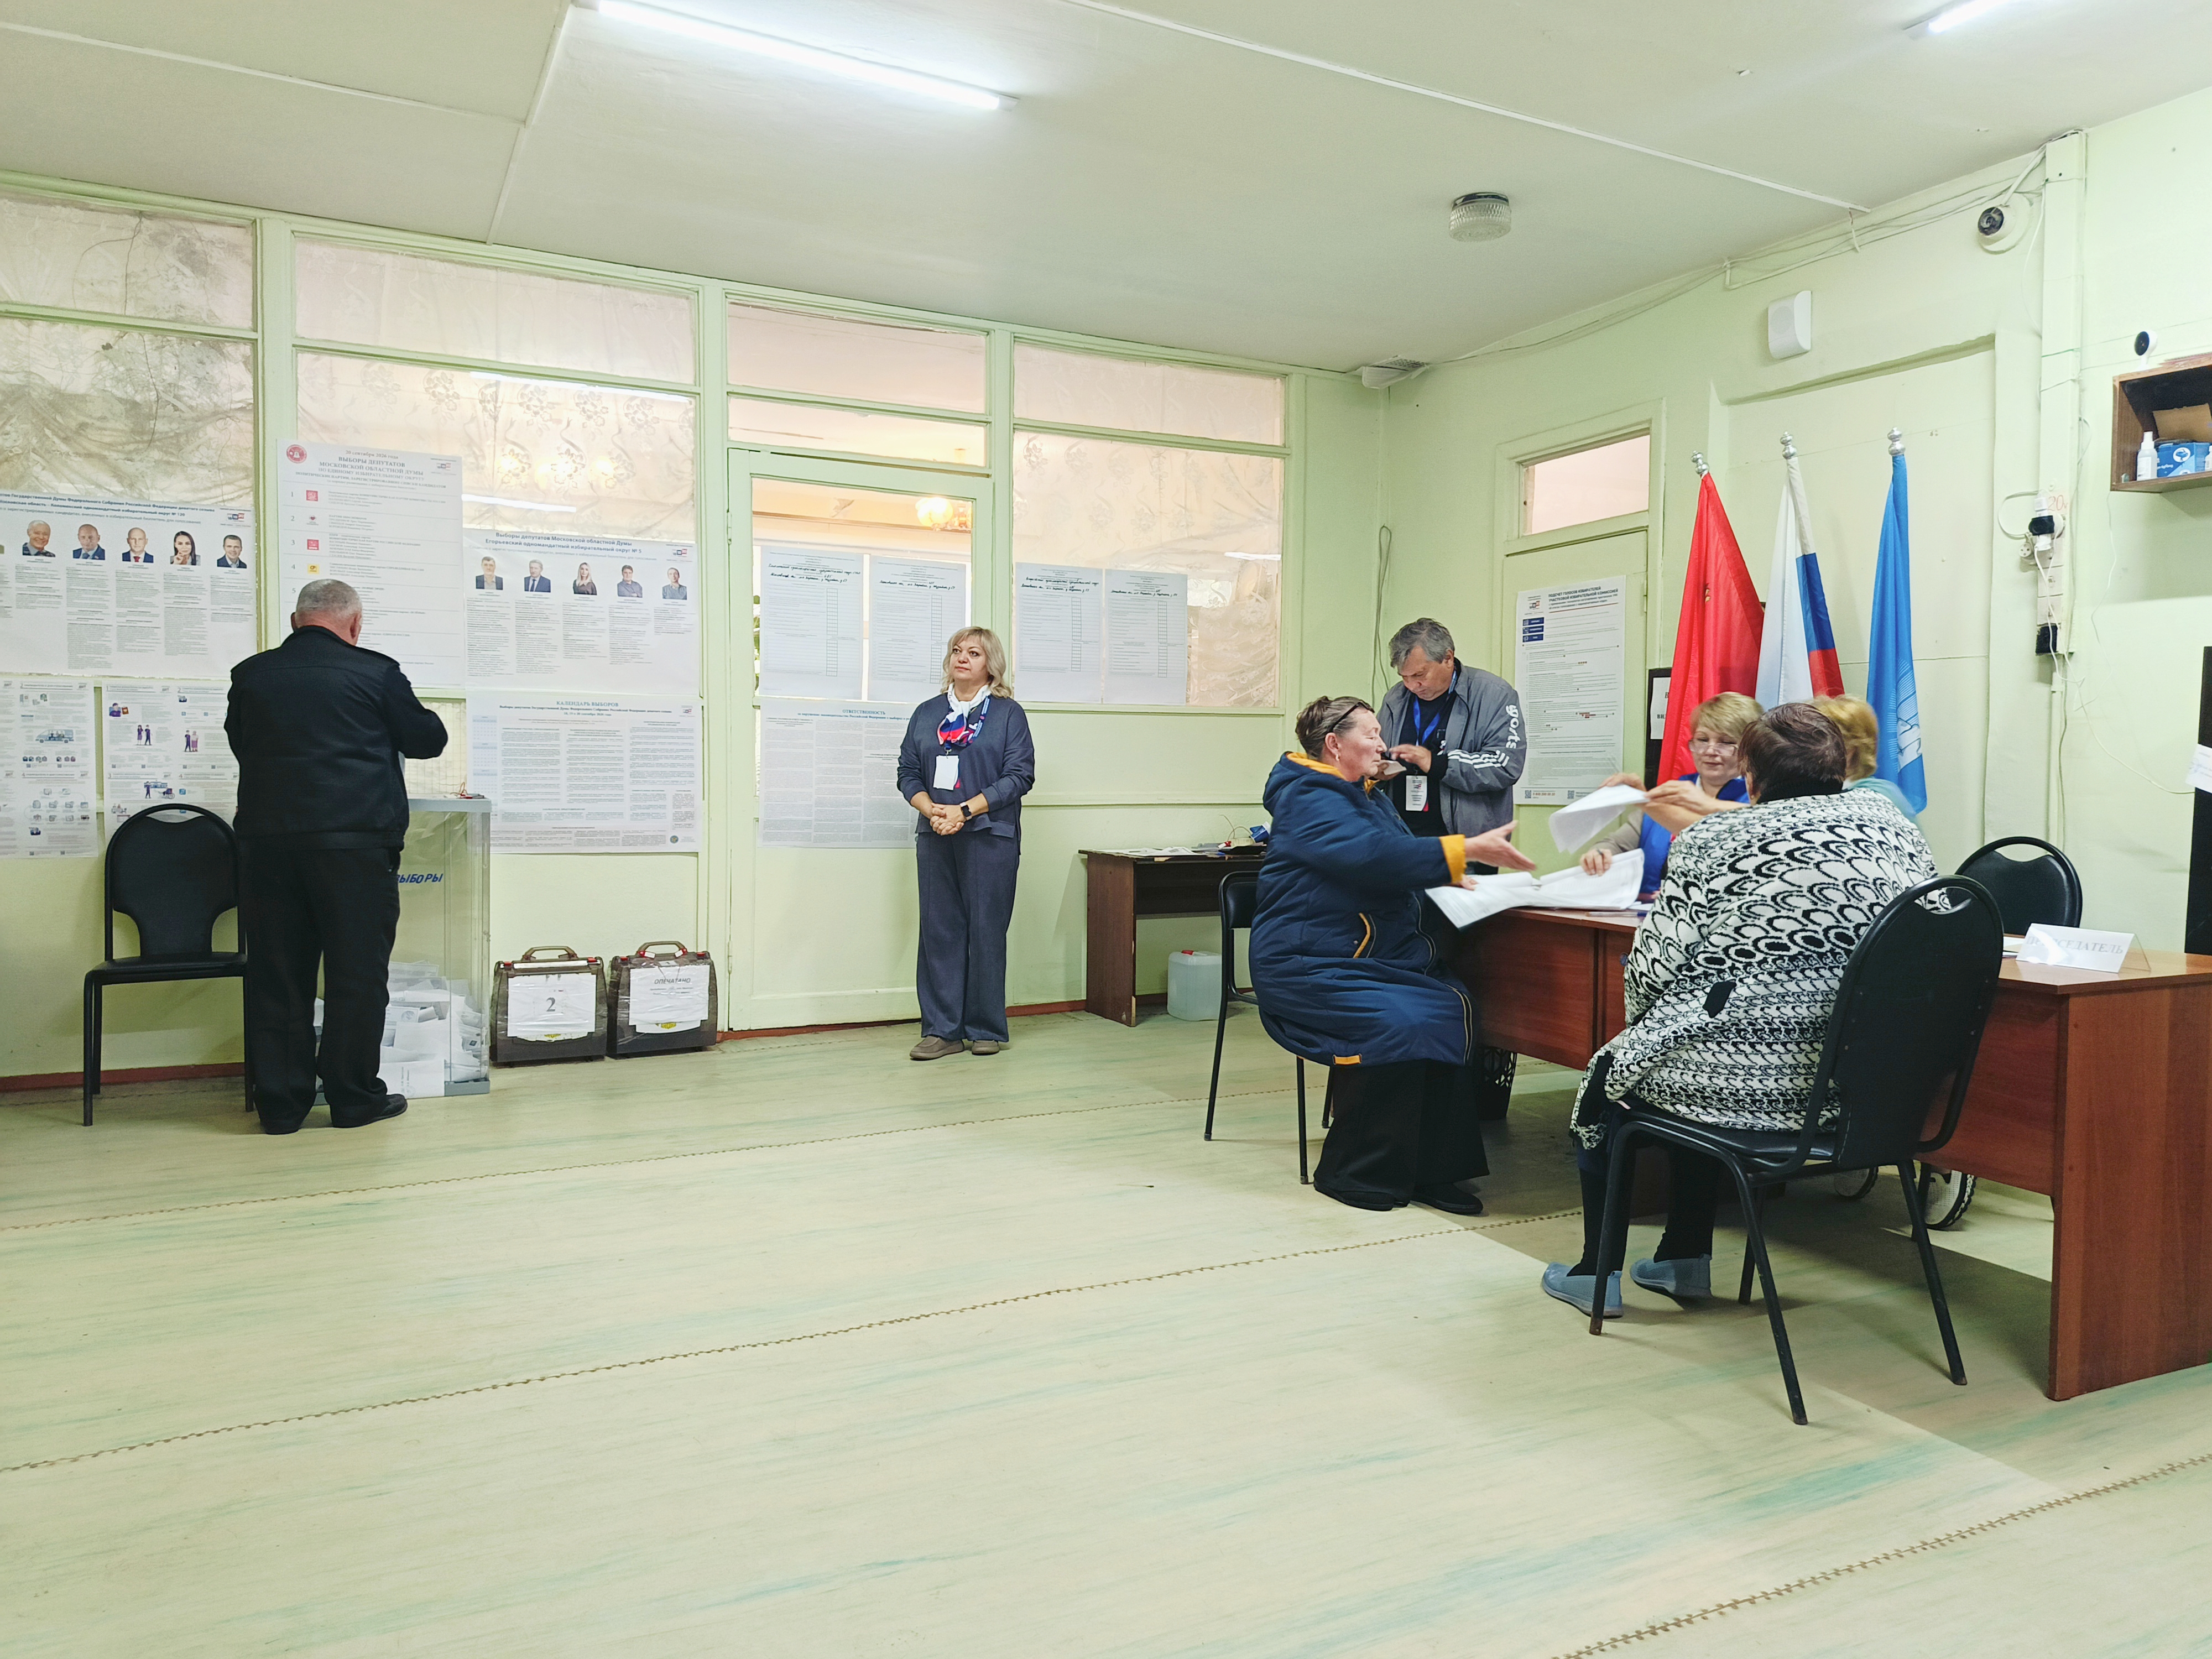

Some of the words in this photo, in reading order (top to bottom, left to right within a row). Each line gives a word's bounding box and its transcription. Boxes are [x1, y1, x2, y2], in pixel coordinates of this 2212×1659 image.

[319, 461, 364, 470] МОСКОВСКОЙ
[365, 466, 404, 474] ОБЛАСТНОЙ
[368, 459, 405, 467] ДЕПУТАТОВ
[2026, 936, 2124, 954] ПРСЕДАТЕЛЬ
[546, 997, 556, 1012] 2
